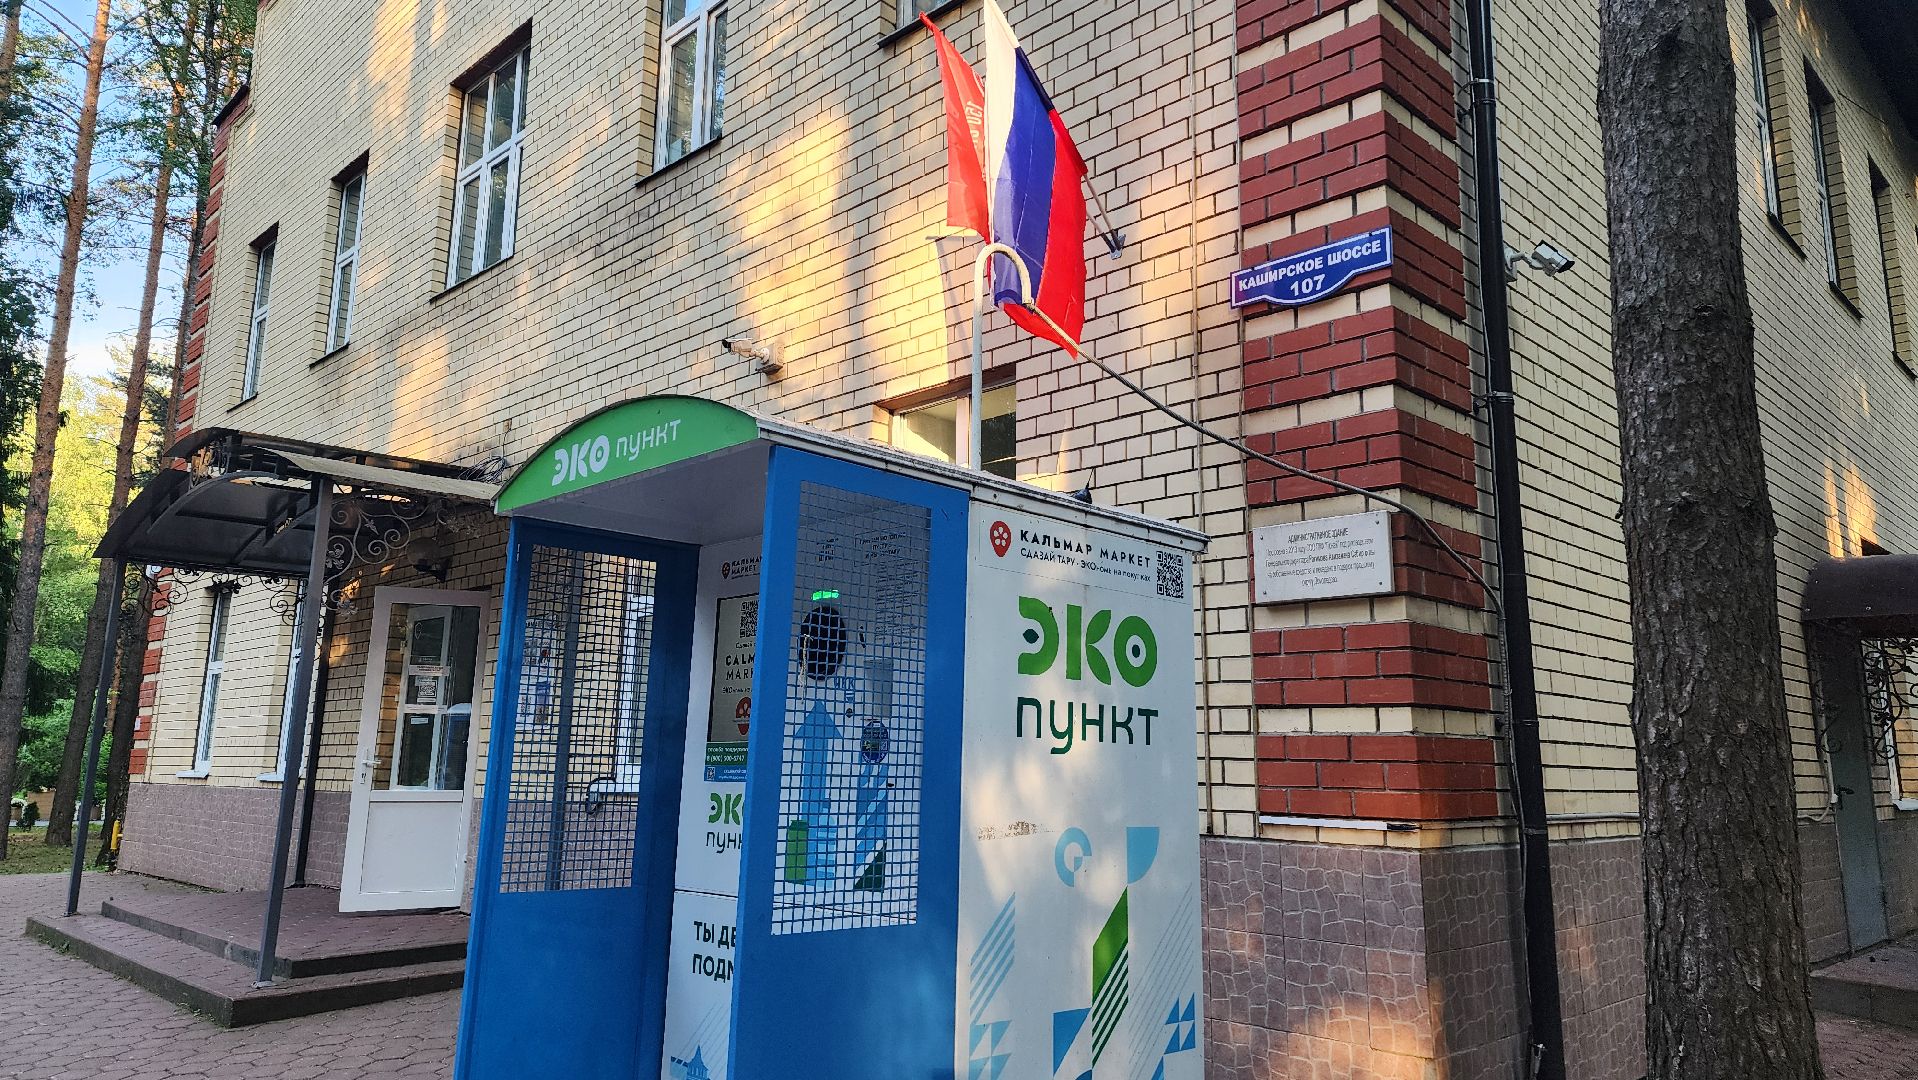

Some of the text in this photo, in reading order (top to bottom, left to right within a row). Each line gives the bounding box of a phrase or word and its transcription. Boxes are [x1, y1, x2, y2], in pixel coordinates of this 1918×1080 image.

[1238, 239, 1381, 291] КАШИРСКОЕ ШОССЕ
[1290, 274, 1325, 296] 107
[552, 435, 610, 486] ЭКО
[1020, 530, 1150, 568] КАЛЬМАР МАРКЕТ
[1057, 555, 1076, 566] ТАРУ
[731, 564, 756, 575] МАРКЕТ
[1018, 595, 1158, 687] ЭКО
[694, 921, 714, 944] ТЫ
